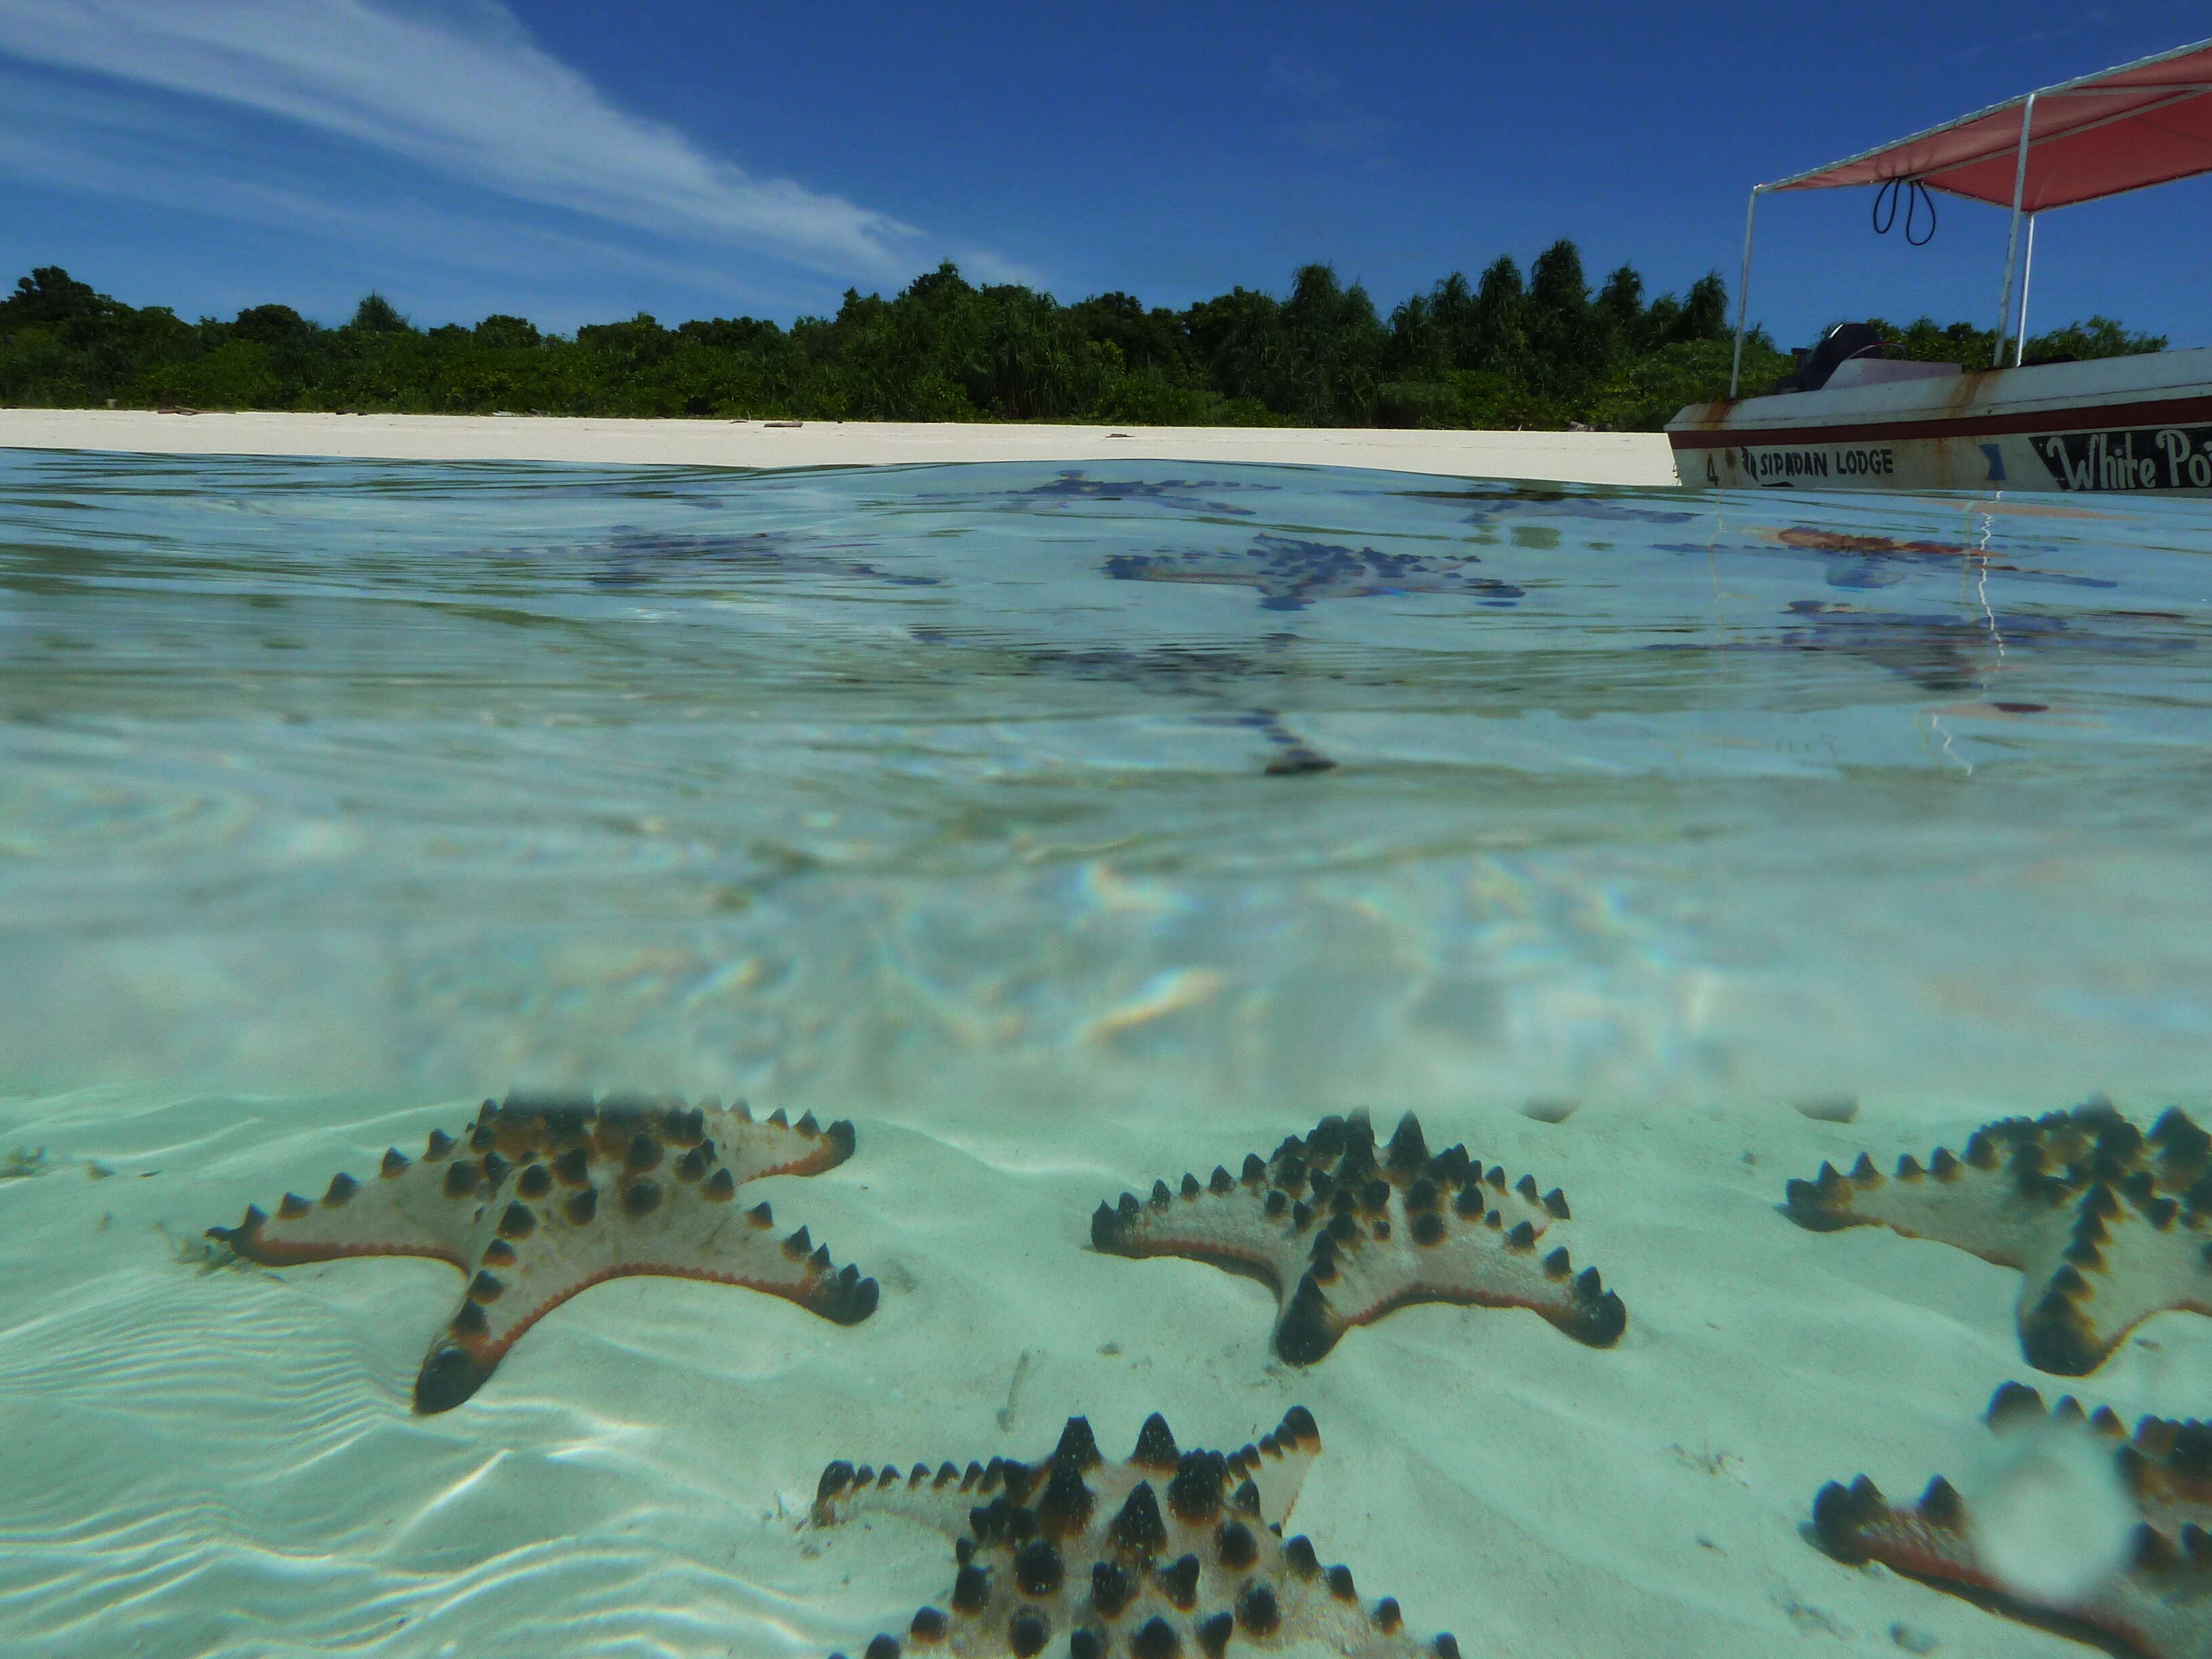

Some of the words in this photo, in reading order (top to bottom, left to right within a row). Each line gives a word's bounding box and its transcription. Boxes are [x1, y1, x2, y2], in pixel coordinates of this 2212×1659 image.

[1760, 451, 1828, 477] SIPADAN
[1837, 449, 1893, 476] LODGE
[2046, 432, 2156, 491] White
